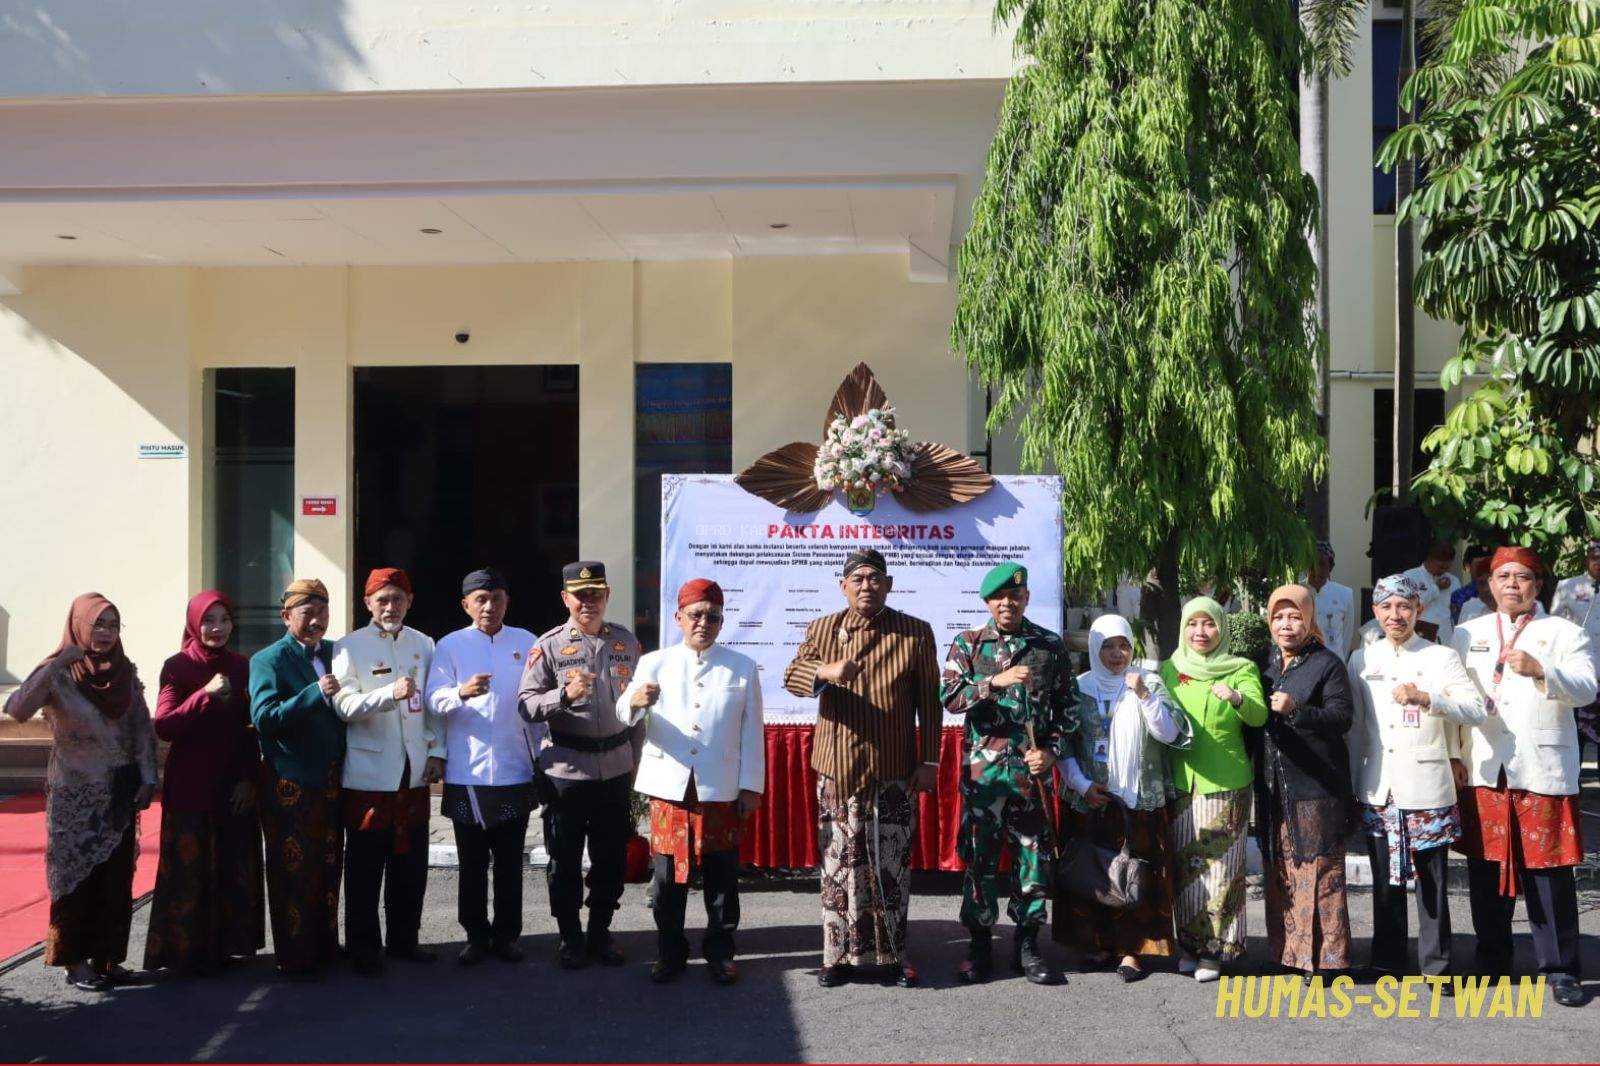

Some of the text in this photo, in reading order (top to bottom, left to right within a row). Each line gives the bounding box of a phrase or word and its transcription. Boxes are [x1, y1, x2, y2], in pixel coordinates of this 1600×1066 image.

[767, 524, 955, 540] PAKTA INTEGRITAS
[688, 543, 709, 551] Dengan
